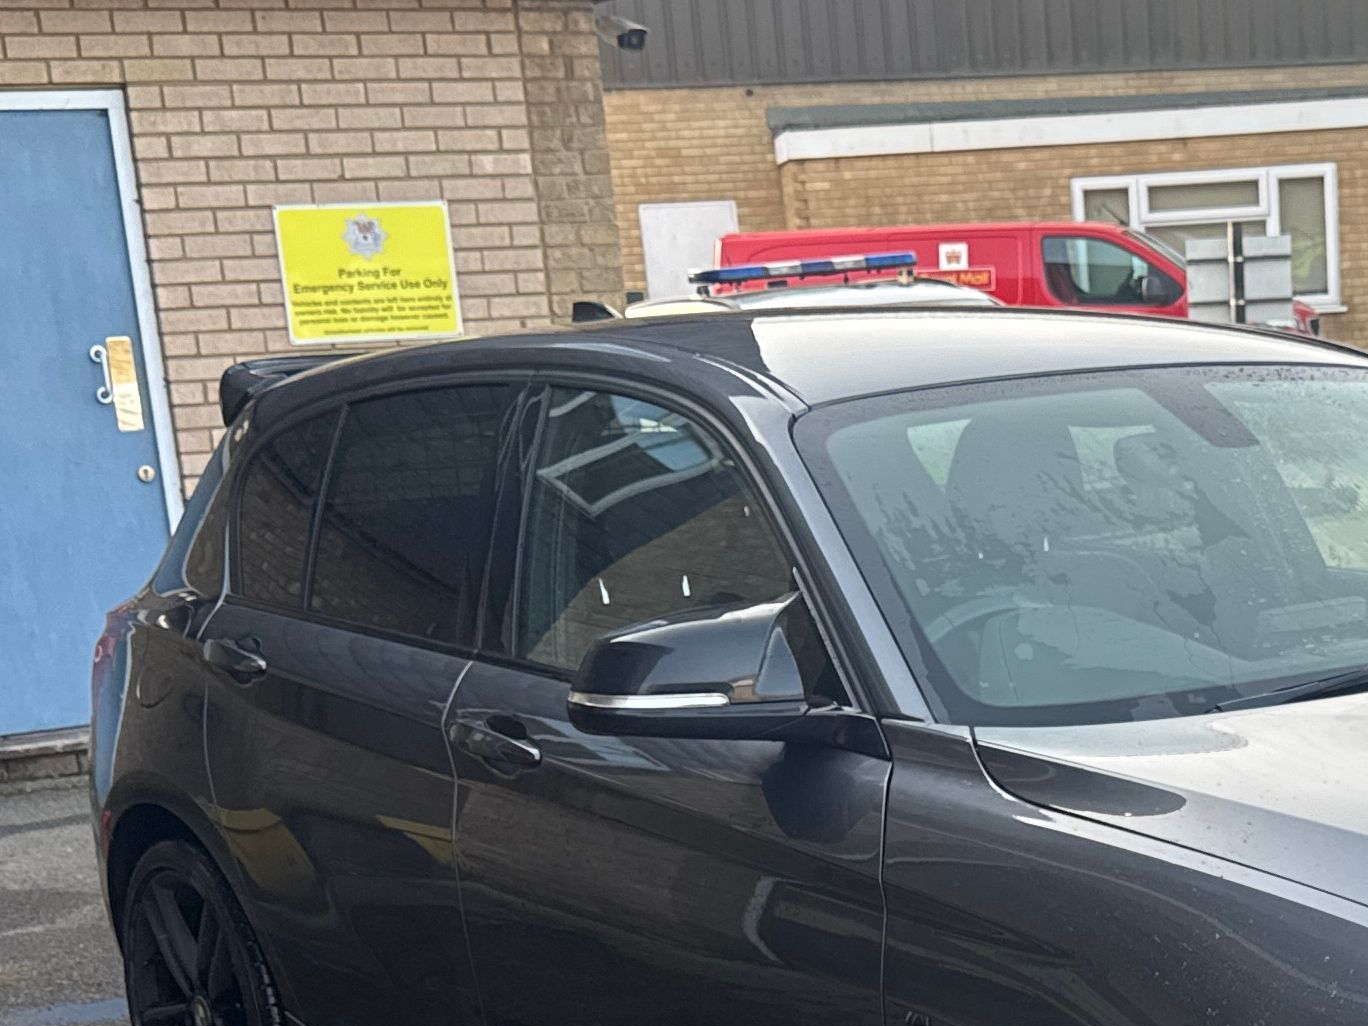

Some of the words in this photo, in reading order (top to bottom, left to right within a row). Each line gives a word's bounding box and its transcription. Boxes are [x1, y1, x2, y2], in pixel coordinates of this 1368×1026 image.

[338, 267, 380, 279] Parking
[382, 266, 401, 277] For
[293, 283, 354, 295] Emergency
[357, 280, 398, 291] Service
[399, 279, 421, 290] Use
[422, 278, 449, 290] Only
